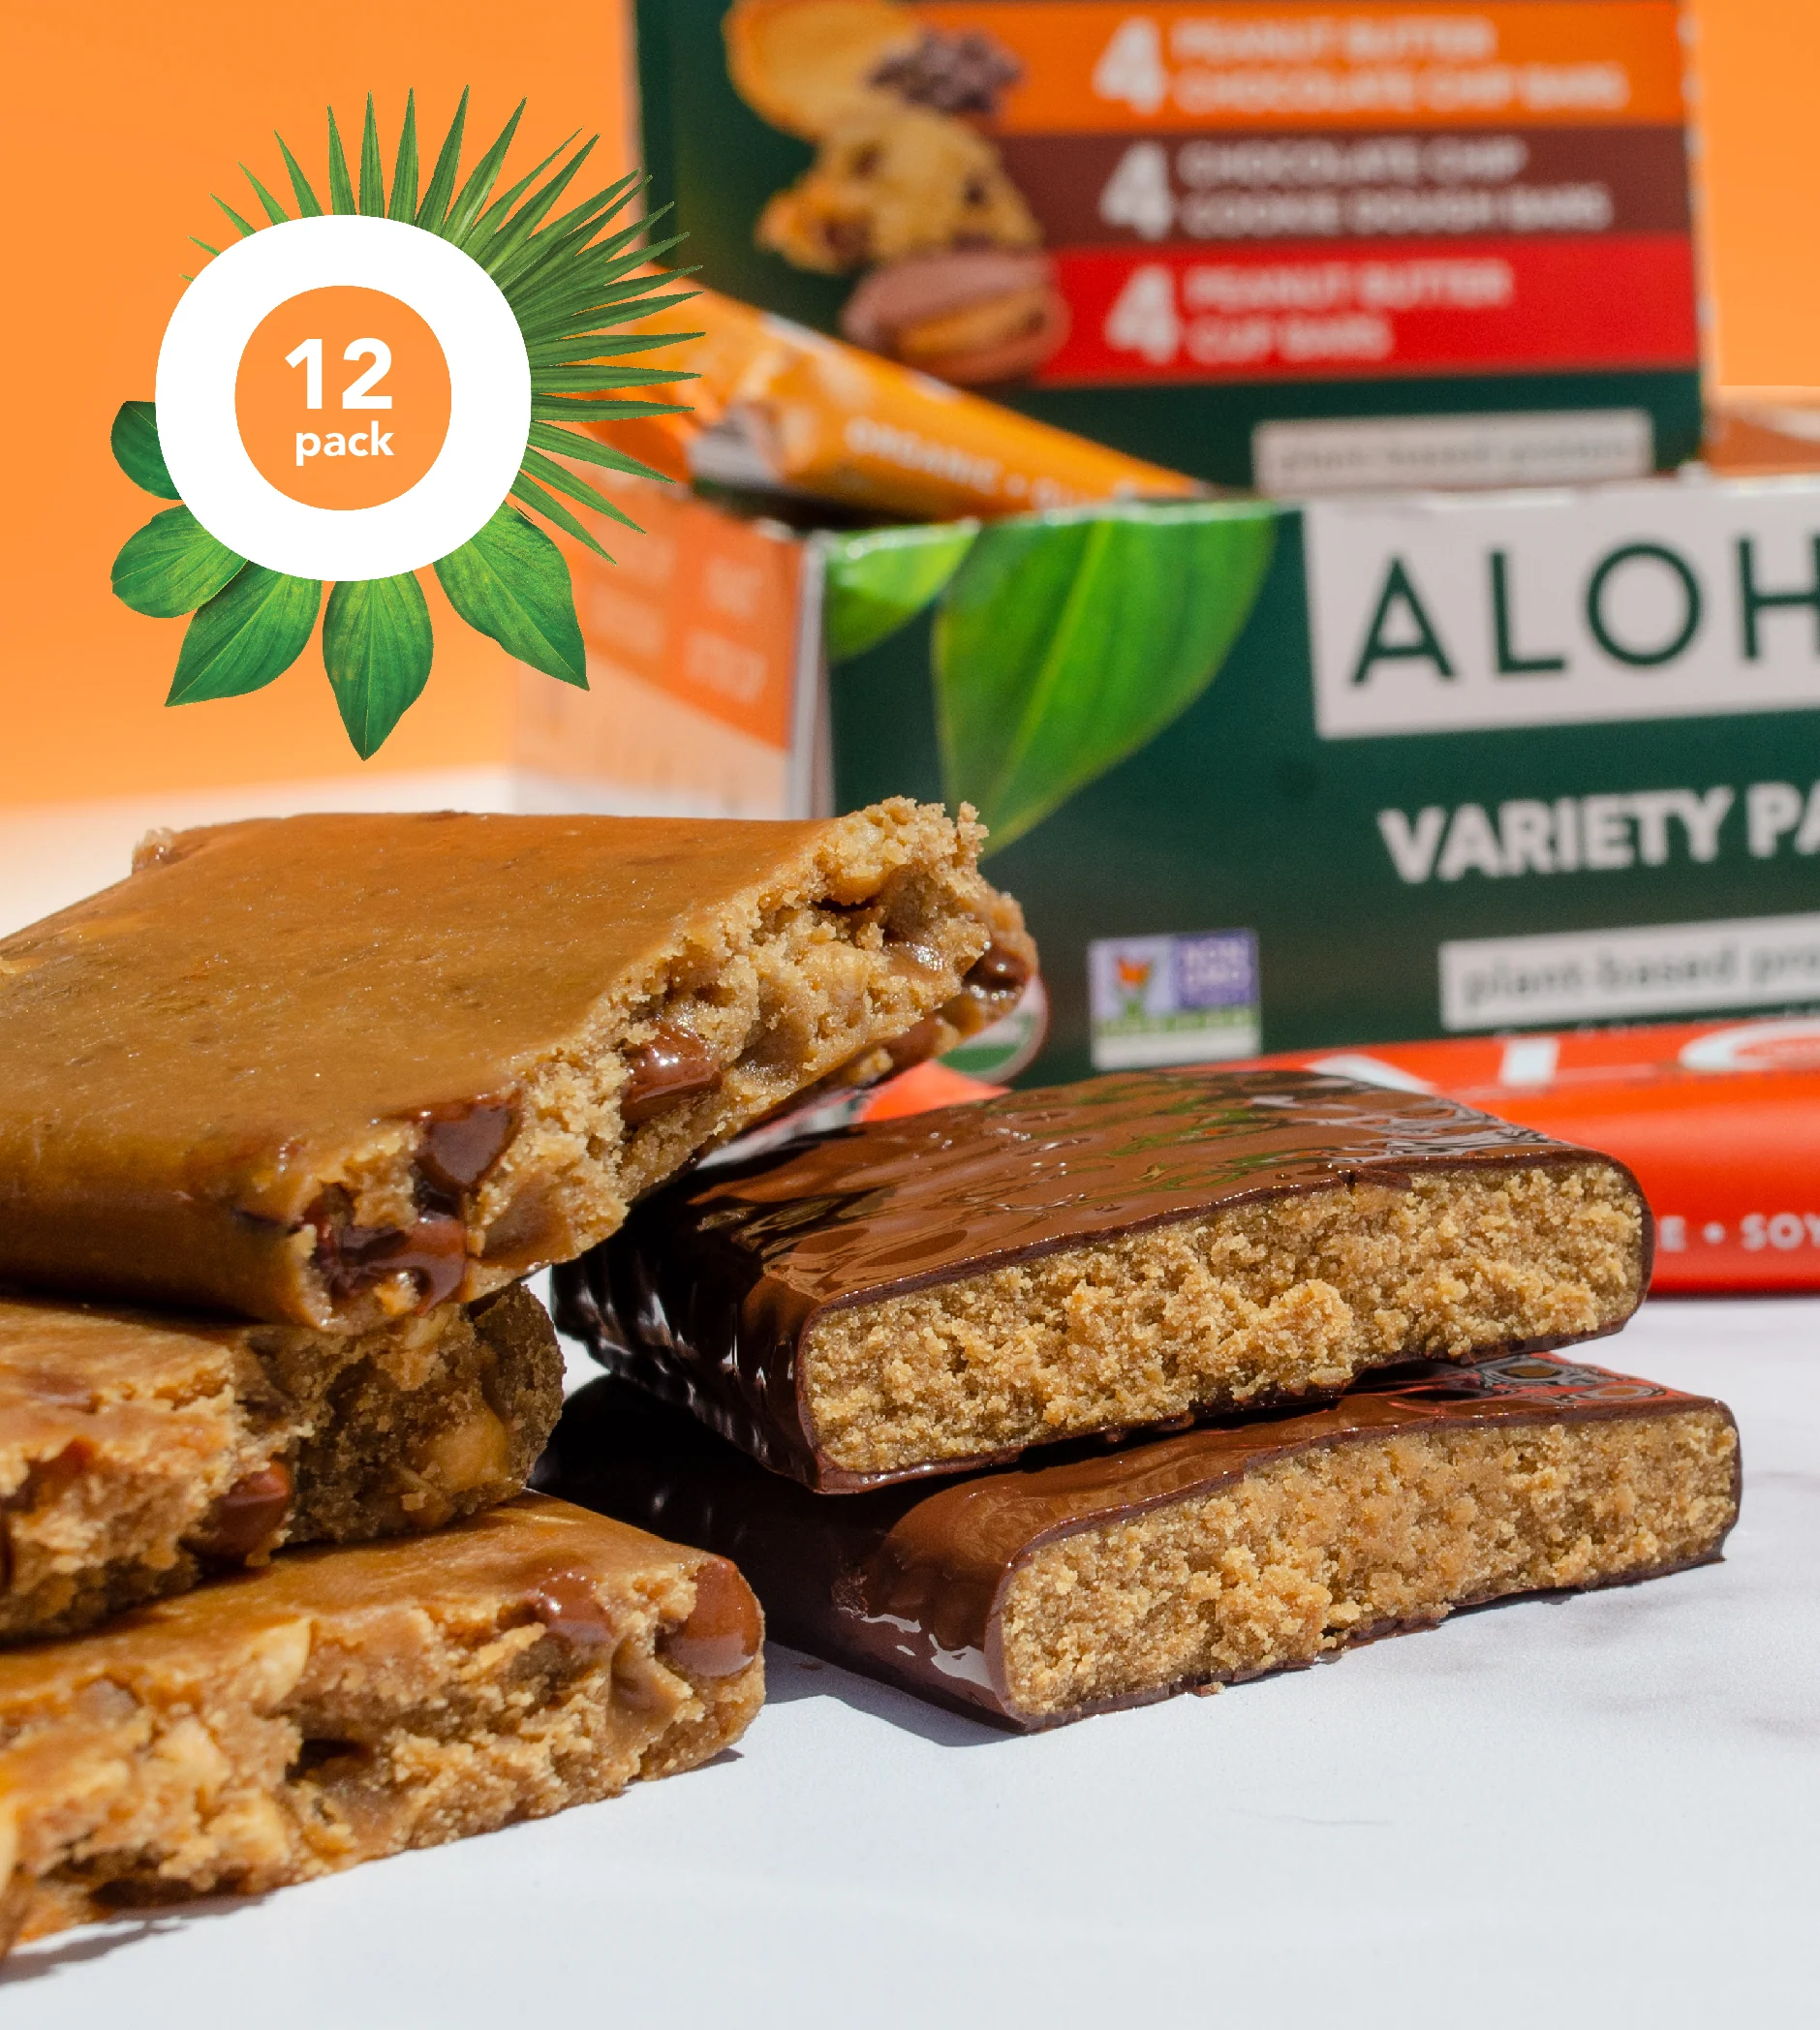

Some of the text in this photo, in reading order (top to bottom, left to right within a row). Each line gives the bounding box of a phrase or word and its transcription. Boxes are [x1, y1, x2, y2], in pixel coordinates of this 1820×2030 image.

[1094, 17, 1165, 112] 4
[1344, 16, 1496, 58] BUTTER
[1099, 141, 1174, 241] 4
[1178, 136, 1528, 187] CHOCOLATE CHIP
[1181, 192, 1340, 237] COOKIE
[1499, 182, 1612, 231] BARS
[1105, 264, 1180, 363] 4
[1357, 259, 1513, 308] BUTTER
[1277, 315, 1394, 361] BARS
[1350, 536, 1820, 686] ALOH
[1377, 785, 1734, 883] VARIETY
